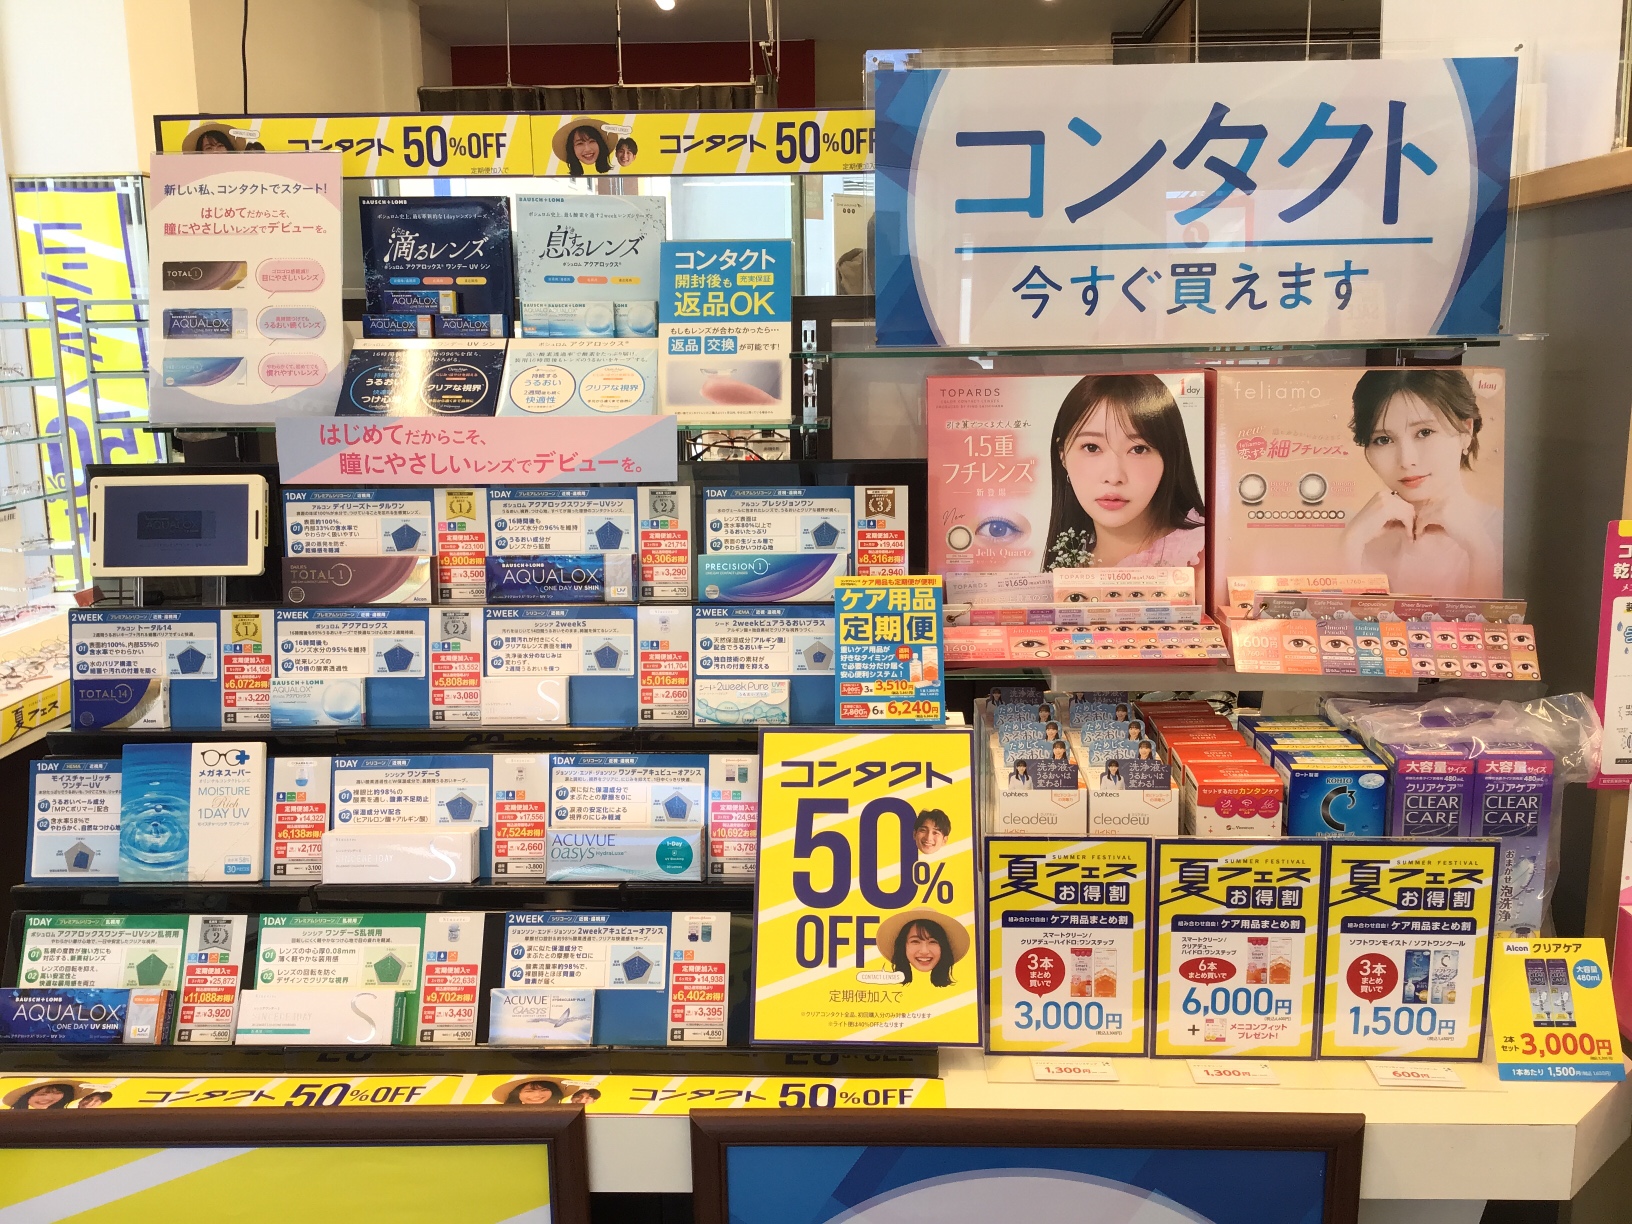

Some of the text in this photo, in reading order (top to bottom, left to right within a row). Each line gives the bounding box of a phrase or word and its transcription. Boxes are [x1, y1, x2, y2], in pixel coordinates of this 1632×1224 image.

[402, 125, 507, 168] 50%OFF
[659, 133, 767, 153] コンタクト
[955, 100, 1438, 224] コンタクト
[164, 182, 328, 196] 新しい私、コンタクトでスタート!
[201, 207, 289, 219] はじめてだからこそ、
[163, 221, 328, 235] 瞳にやさしいレンズでデビューを。
[383, 231, 489, 262] 滴るレンズ
[675, 249, 776, 270] コンタクト
[675, 274, 732, 289] 開封後も
[1012, 260, 1370, 317] 今すぐ買えます
[674, 292, 775, 316] 返品OK
[172, 319, 229, 328] AQUALOX
[671, 338, 735, 352] 返品 交換
[1234, 381, 1321, 399] feliamo
[1478, 380, 1497, 390] 1day
[940, 388, 1000, 396] TOPARDS
[319, 424, 487, 446] はじめてだからこそ、
[1238, 426, 1264, 437] new
[964, 435, 1014, 457] 1.5重
[1268, 438, 1342, 458] 細フチレンズ
[339, 452, 643, 475] 瞳にやさしいレンズでデビューを。
[943, 459, 1035, 484] フチレンズ
[285, 492, 307, 500] 1DAY
[976, 549, 1032, 558] Jelly Quartz
[440, 557, 485, 565] ¥9,900お得!
[705, 563, 754, 571] PRECISION
[290, 570, 334, 580] TOTAL
[503, 569, 599, 584] AQUALOX
[662, 568, 686, 576] ¥3,290
[841, 588, 936, 611] ケア用品
[277, 611, 308, 619] 2WEEK
[696, 608, 728, 616] 2WEEK
[843, 615, 934, 642] 定期便
[840, 654, 895, 662] 好きなタイミング
[875, 680, 914, 692] 3,510円
[244, 694, 270, 702] ¥3,220
[453, 692, 478, 700] ¥3,080
[887, 701, 939, 715] 6,240円
[198, 769, 251, 777] メガネスーパー
[1406, 761, 1467, 773] 大容量サイズ
[1486, 761, 1547, 773] 大容量サイズ
[781, 761, 953, 789] コンタクト
[198, 786, 250, 796] MOISTURE
[1202, 787, 1280, 795] セットするだけカンタンケア
[212, 796, 239, 808] Rich
[1406, 796, 1459, 809] CLEAR
[1485, 796, 1538, 809] CLEAR
[198, 808, 250, 819] 1DAY UV
[1003, 814, 1058, 825] cleadew
[1094, 814, 1149, 825] cleadew
[1406, 812, 1458, 824] CARE
[1485, 812, 1538, 824] CARE
[552, 834, 615, 846] ACUVUE
[516, 843, 543, 851] ¥2,660
[793, 796, 954, 909] 50%
[551, 847, 595, 862] oasys
[989, 854, 1138, 903] 夏フェス
[1159, 858, 1311, 906] 夏フェス
[1329, 859, 1484, 908] 夏フェス
[1059, 885, 1126, 902] お得割
[1231, 889, 1300, 906] お得割
[1401, 891, 1471, 908] お得割
[29, 918, 52, 926] 1DAY
[262, 917, 287, 926] 1DAY
[509, 915, 544, 923] 2WEEK
[1050, 915, 1128, 925] ケア用品まとめ割
[1221, 920, 1300, 930] ケア用品まとめ割
[1391, 921, 1471, 931] ケア用品まとめ割
[325, 929, 382, 937] ワンデーS乱視用
[795, 915, 880, 969] OFF
[1532, 943, 1582, 953] クリアケア
[1027, 954, 1054, 970] 3本
[1199, 960, 1217, 971] 6本
[1359, 960, 1387, 976] 3本
[1576, 965, 1598, 973] 大容量
[1188, 972, 1227, 980] まとめ買いで
[1361, 977, 1383, 985] まとめ
[1360, 985, 1383, 993] 買いで
[504, 996, 548, 1005] ACUVUE
[829, 990, 903, 1003] 定期便加入で
[1182, 987, 1292, 1017] 6,000円
[13, 1004, 121, 1022] AQUALOX
[203, 1009, 231, 1018] ¥3,920
[445, 1009, 472, 1018] ¥3,430
[694, 1008, 722, 1017] ¥3,395
[1014, 1001, 1122, 1031] 3,000円
[1230, 1023, 1287, 1031] メニコンフィット
[1350, 1006, 1455, 1037] 1,500円
[1520, 1032, 1612, 1058] 3,000円
[138, 1089, 276, 1103] コンタクト
[629, 1083, 914, 1108] コンタクト 50%OFF
